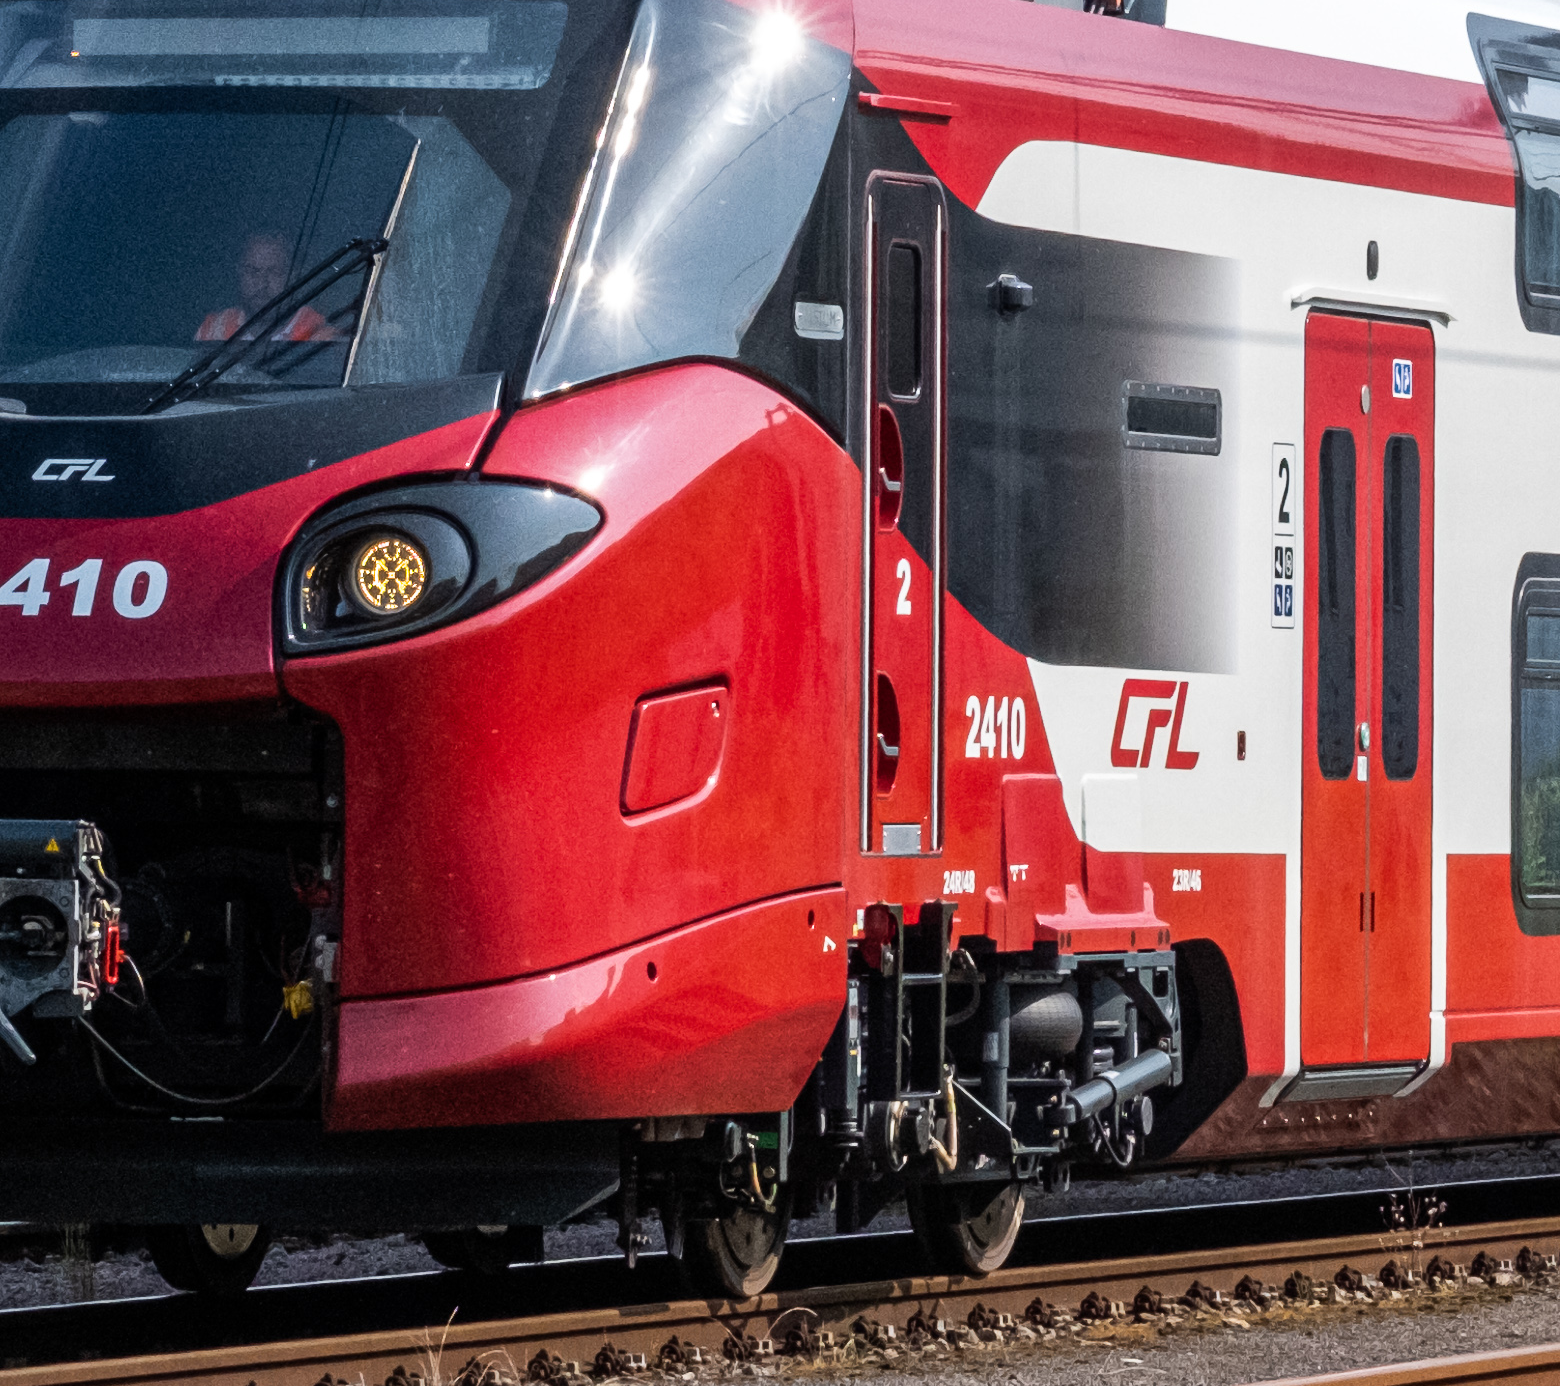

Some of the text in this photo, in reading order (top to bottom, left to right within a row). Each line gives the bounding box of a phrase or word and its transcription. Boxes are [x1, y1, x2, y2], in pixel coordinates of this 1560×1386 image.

[32, 458, 116, 481] CFL
[1278, 457, 1290, 524] 2
[896, 557, 912, 616] 2
[965, 695, 1025, 760] 2410
[1111, 678, 1200, 770] CFL
